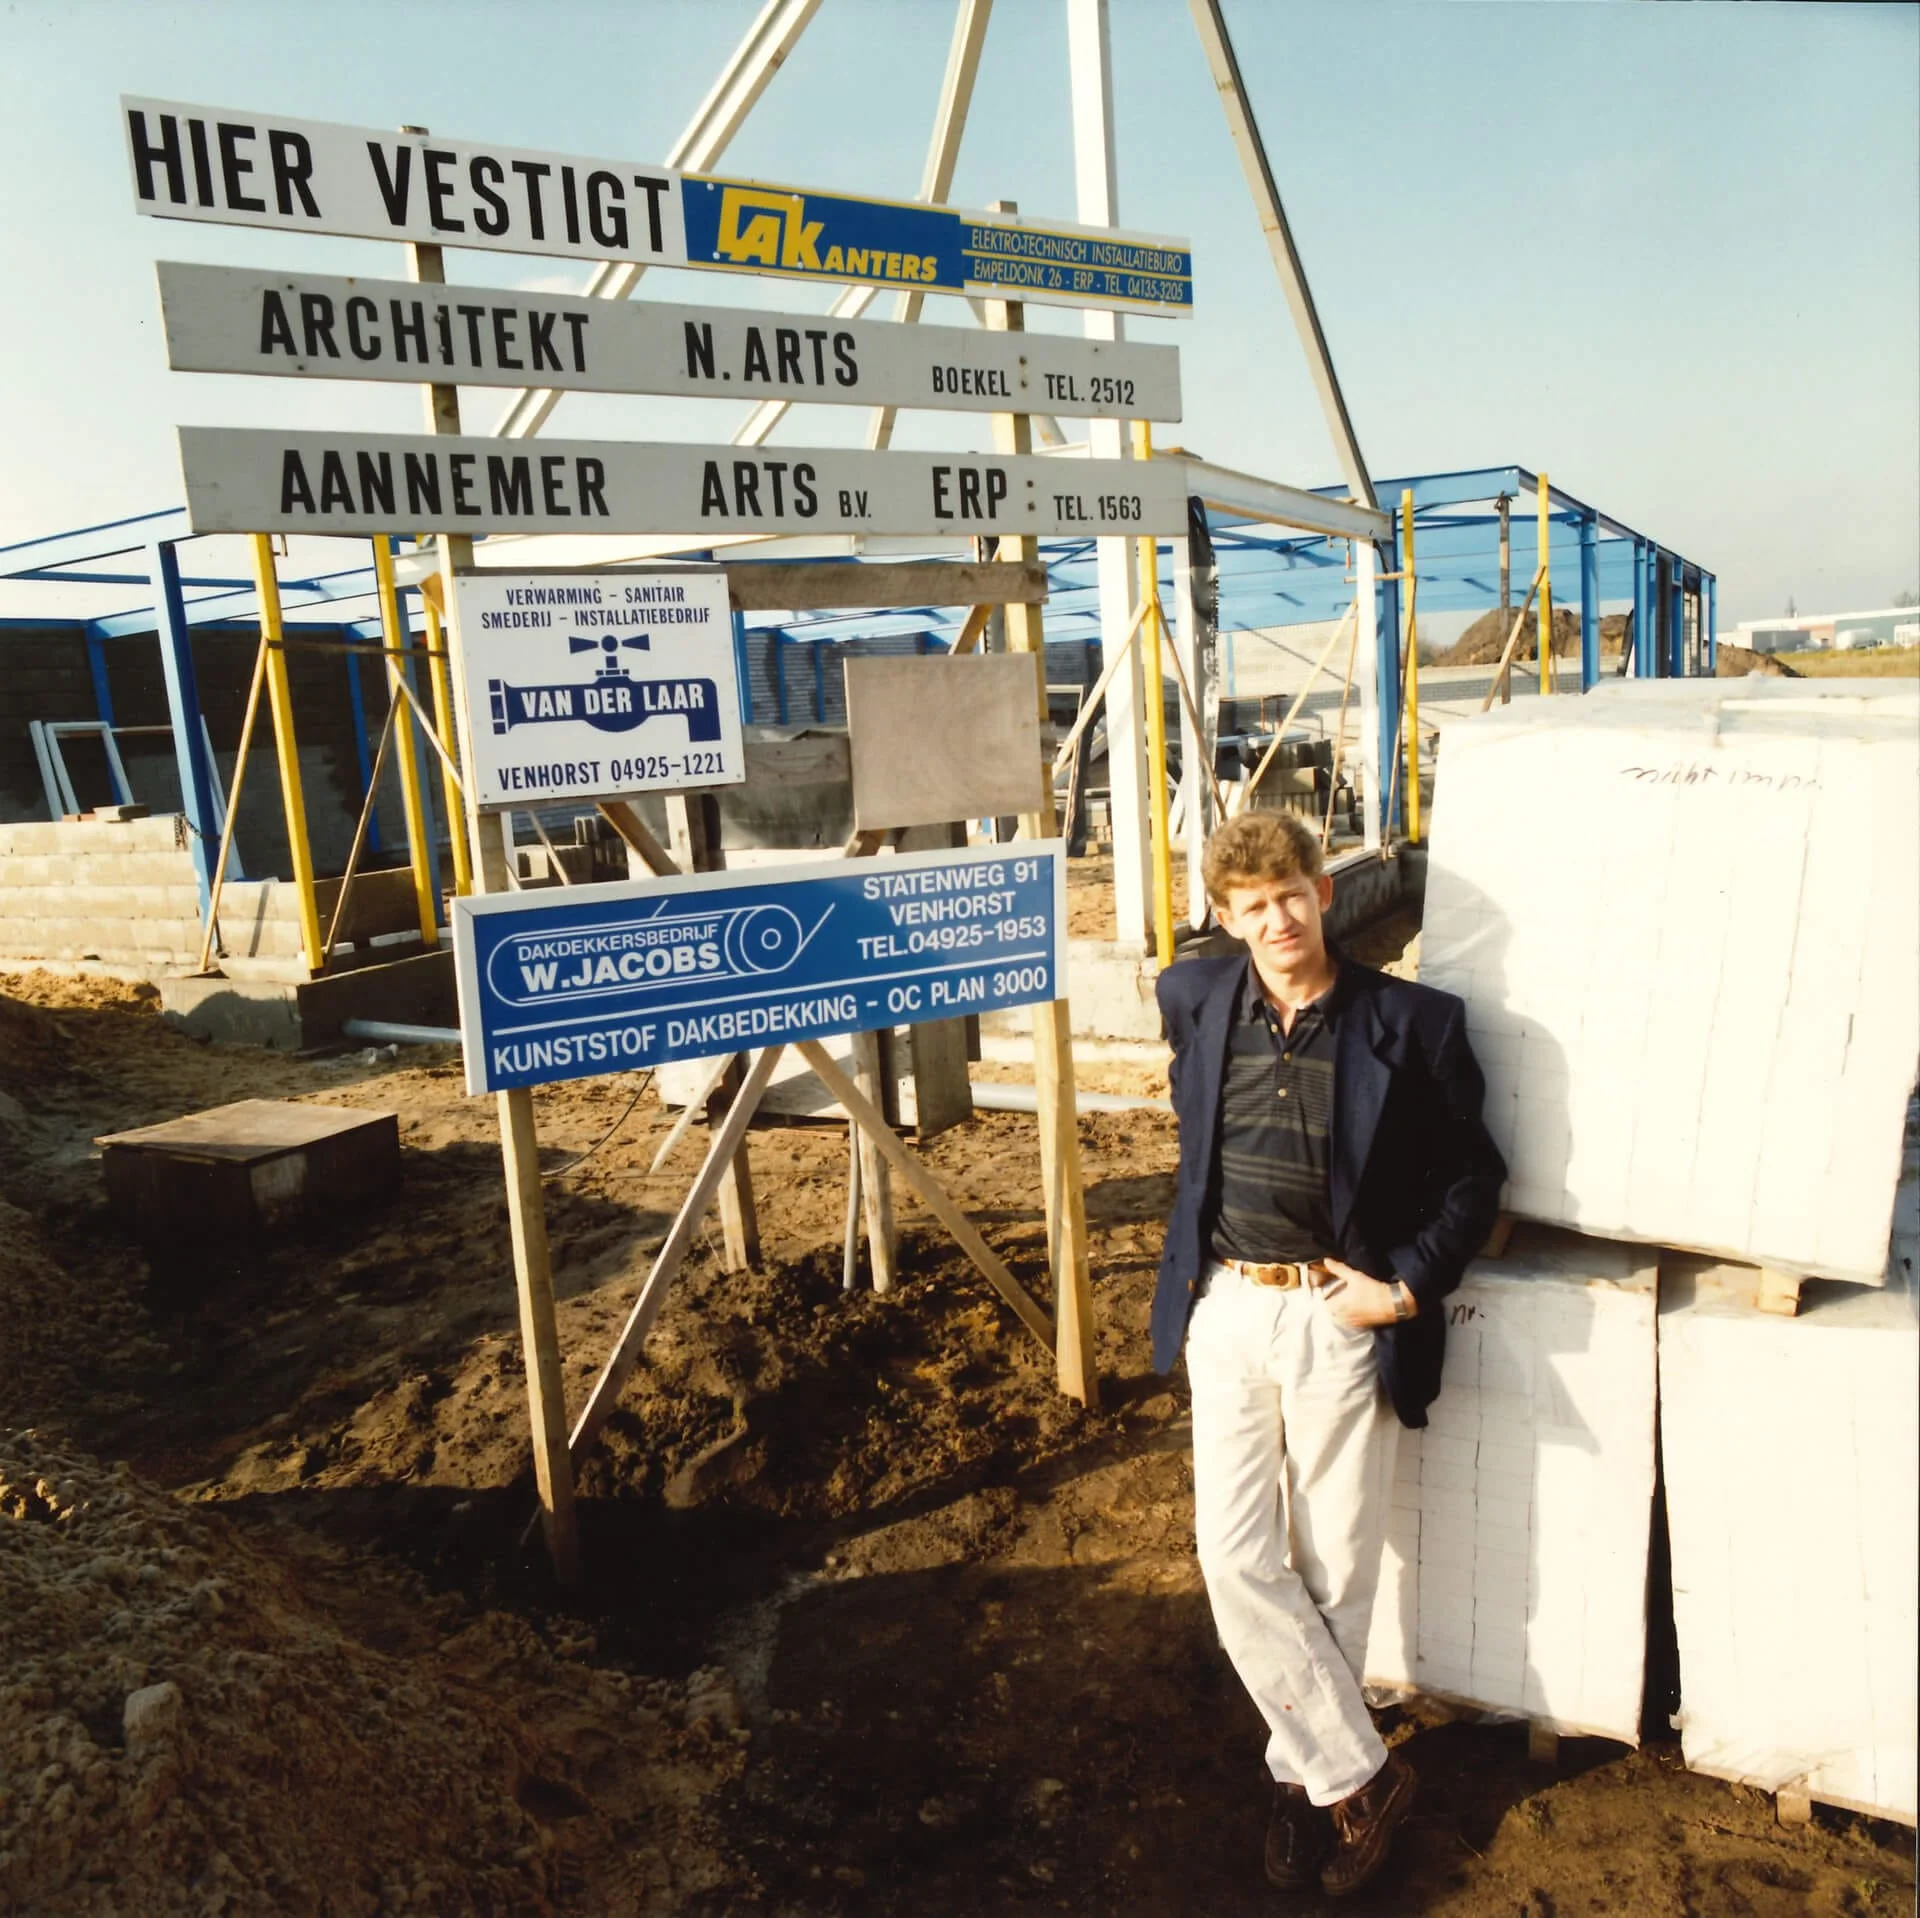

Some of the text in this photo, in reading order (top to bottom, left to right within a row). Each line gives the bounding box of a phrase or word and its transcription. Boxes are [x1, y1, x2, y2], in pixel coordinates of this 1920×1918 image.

[127, 110, 671, 253] HIER VESTIGT
[971, 228, 1183, 273] ELEKTRO-TECHNISCH INSTALLATIEBURO
[973, 258, 1045, 287] EMPELDONK
[1048, 268, 1062, 288] 26
[1073, 270, 1094, 290] ERP
[260, 290, 590, 373] ARCHITEKT
[932, 365, 1012, 397] BOEKEL
[280, 449, 611, 517] AANNEMER
[700, 460, 819, 518] ARTS
[838, 490, 872, 519] B.V.
[932, 466, 1008, 519] ERP
[506, 588, 602, 606] VERWARMING
[625, 586, 685, 604] SANITAIR
[481, 612, 551, 630] SMEDERIJ
[574, 607, 711, 627] INSTALLATIEBEDRIJF
[521, 683, 705, 718] VAN DER LAAR
[498, 751, 725, 791] VENHORST 04925-1221
[863, 859, 1040, 900] STATENWEG 91
[889, 890, 1017, 927] VENHORST
[517, 922, 719, 963] DAKDEKKERSBEDRIJF
[493, 1024, 657, 1075] KUNSTSTOF
[666, 993, 858, 1049] DAKBEDEKKING
[887, 984, 922, 1014] OC
[930, 975, 985, 1007] PLAN
[992, 965, 1048, 997] 3000
